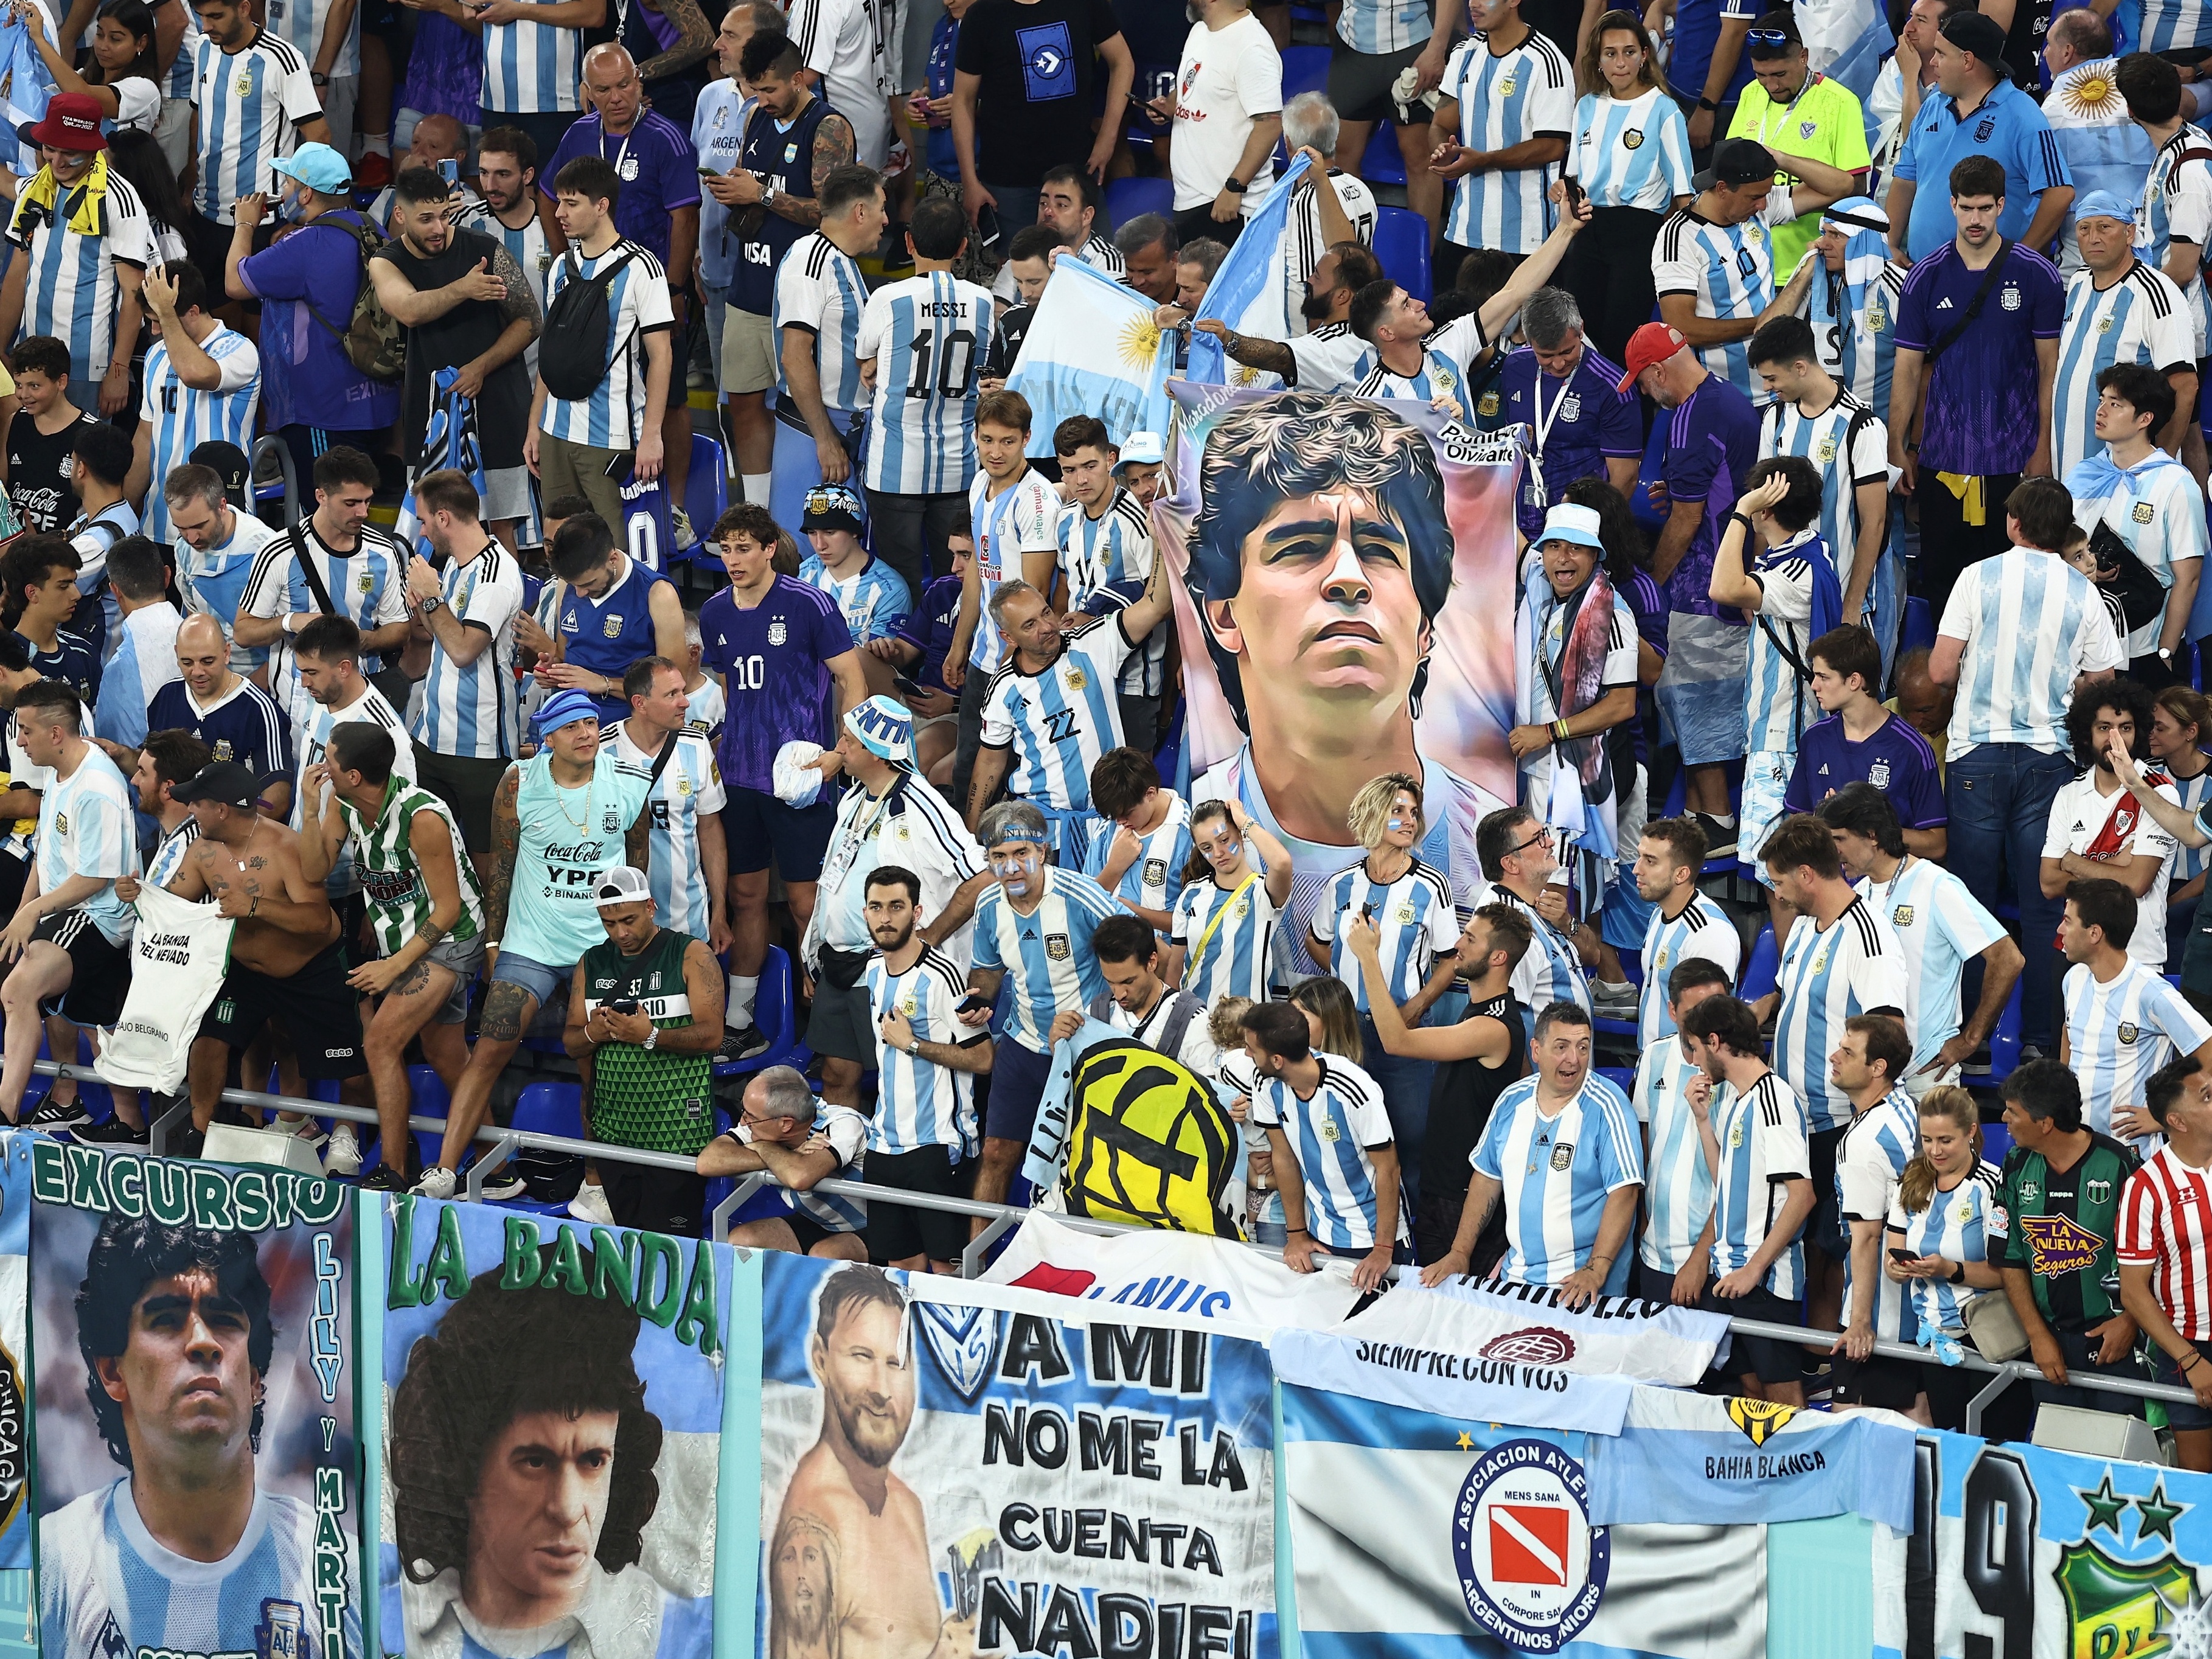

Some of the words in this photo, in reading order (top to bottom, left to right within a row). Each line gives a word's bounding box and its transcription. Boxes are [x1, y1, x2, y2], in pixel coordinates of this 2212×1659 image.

[920, 302, 967, 319] MESSI
[909, 329, 975, 398] 10
[159, 385, 178, 414] 10
[2137, 507, 2150, 520] 86
[732, 655, 765, 690] 10
[1042, 707, 1082, 744] 22
[543, 841, 605, 863] Coca-Cola
[547, 864, 604, 886] YPF
[1897, 910, 1910, 921] 86
[150, 933, 161, 947] LA
[162, 934, 190, 948] BANDA
[155, 948, 190, 966] NEVADO
[116, 1020, 133, 1032] BAJO
[135, 1023, 169, 1042] BELGRANO
[2036, 1237, 2090, 1252] NUEVA
[2051, 1224, 2071, 1239] LA
[386, 1194, 471, 1312] LA
[500, 1216, 723, 1357] BANDA
[2034, 1254, 2093, 1275] Seguros
[310, 1232, 343, 1403] LILY
[1001, 1312, 1069, 1380] A
[1089, 1324, 1208, 1393] MI
[1356, 1340, 1459, 1379] SIEMPRE
[1462, 1357, 1514, 1386] CON
[1523, 1365, 1568, 1393] VOS
[0, 1369, 19, 1501] CHICAGO
[319, 1416, 337, 1453] Y
[982, 1403, 1069, 1470] NO
[1078, 1410, 1164, 1481] ME
[1179, 1422, 1248, 1492] LA
[1705, 1455, 1755, 1480] BAHIA
[1758, 1450, 1826, 1478] BLANCA
[1458, 1445, 1540, 1532] ASOCIACION
[1544, 1452, 1606, 1538] ATLEA
[1504, 1490, 1532, 1502] MENS
[1534, 1492, 1561, 1503] SANA
[999, 1501, 1223, 1578] CUENTA
[1905, 1437, 2037, 1659] 19
[1531, 1589, 1541, 1599] IN
[1463, 1578, 1553, 1649] ARGENTINOS
[1563, 1584, 1601, 1646] NIORS
[1501, 1598, 1545, 1621] CORPORE
